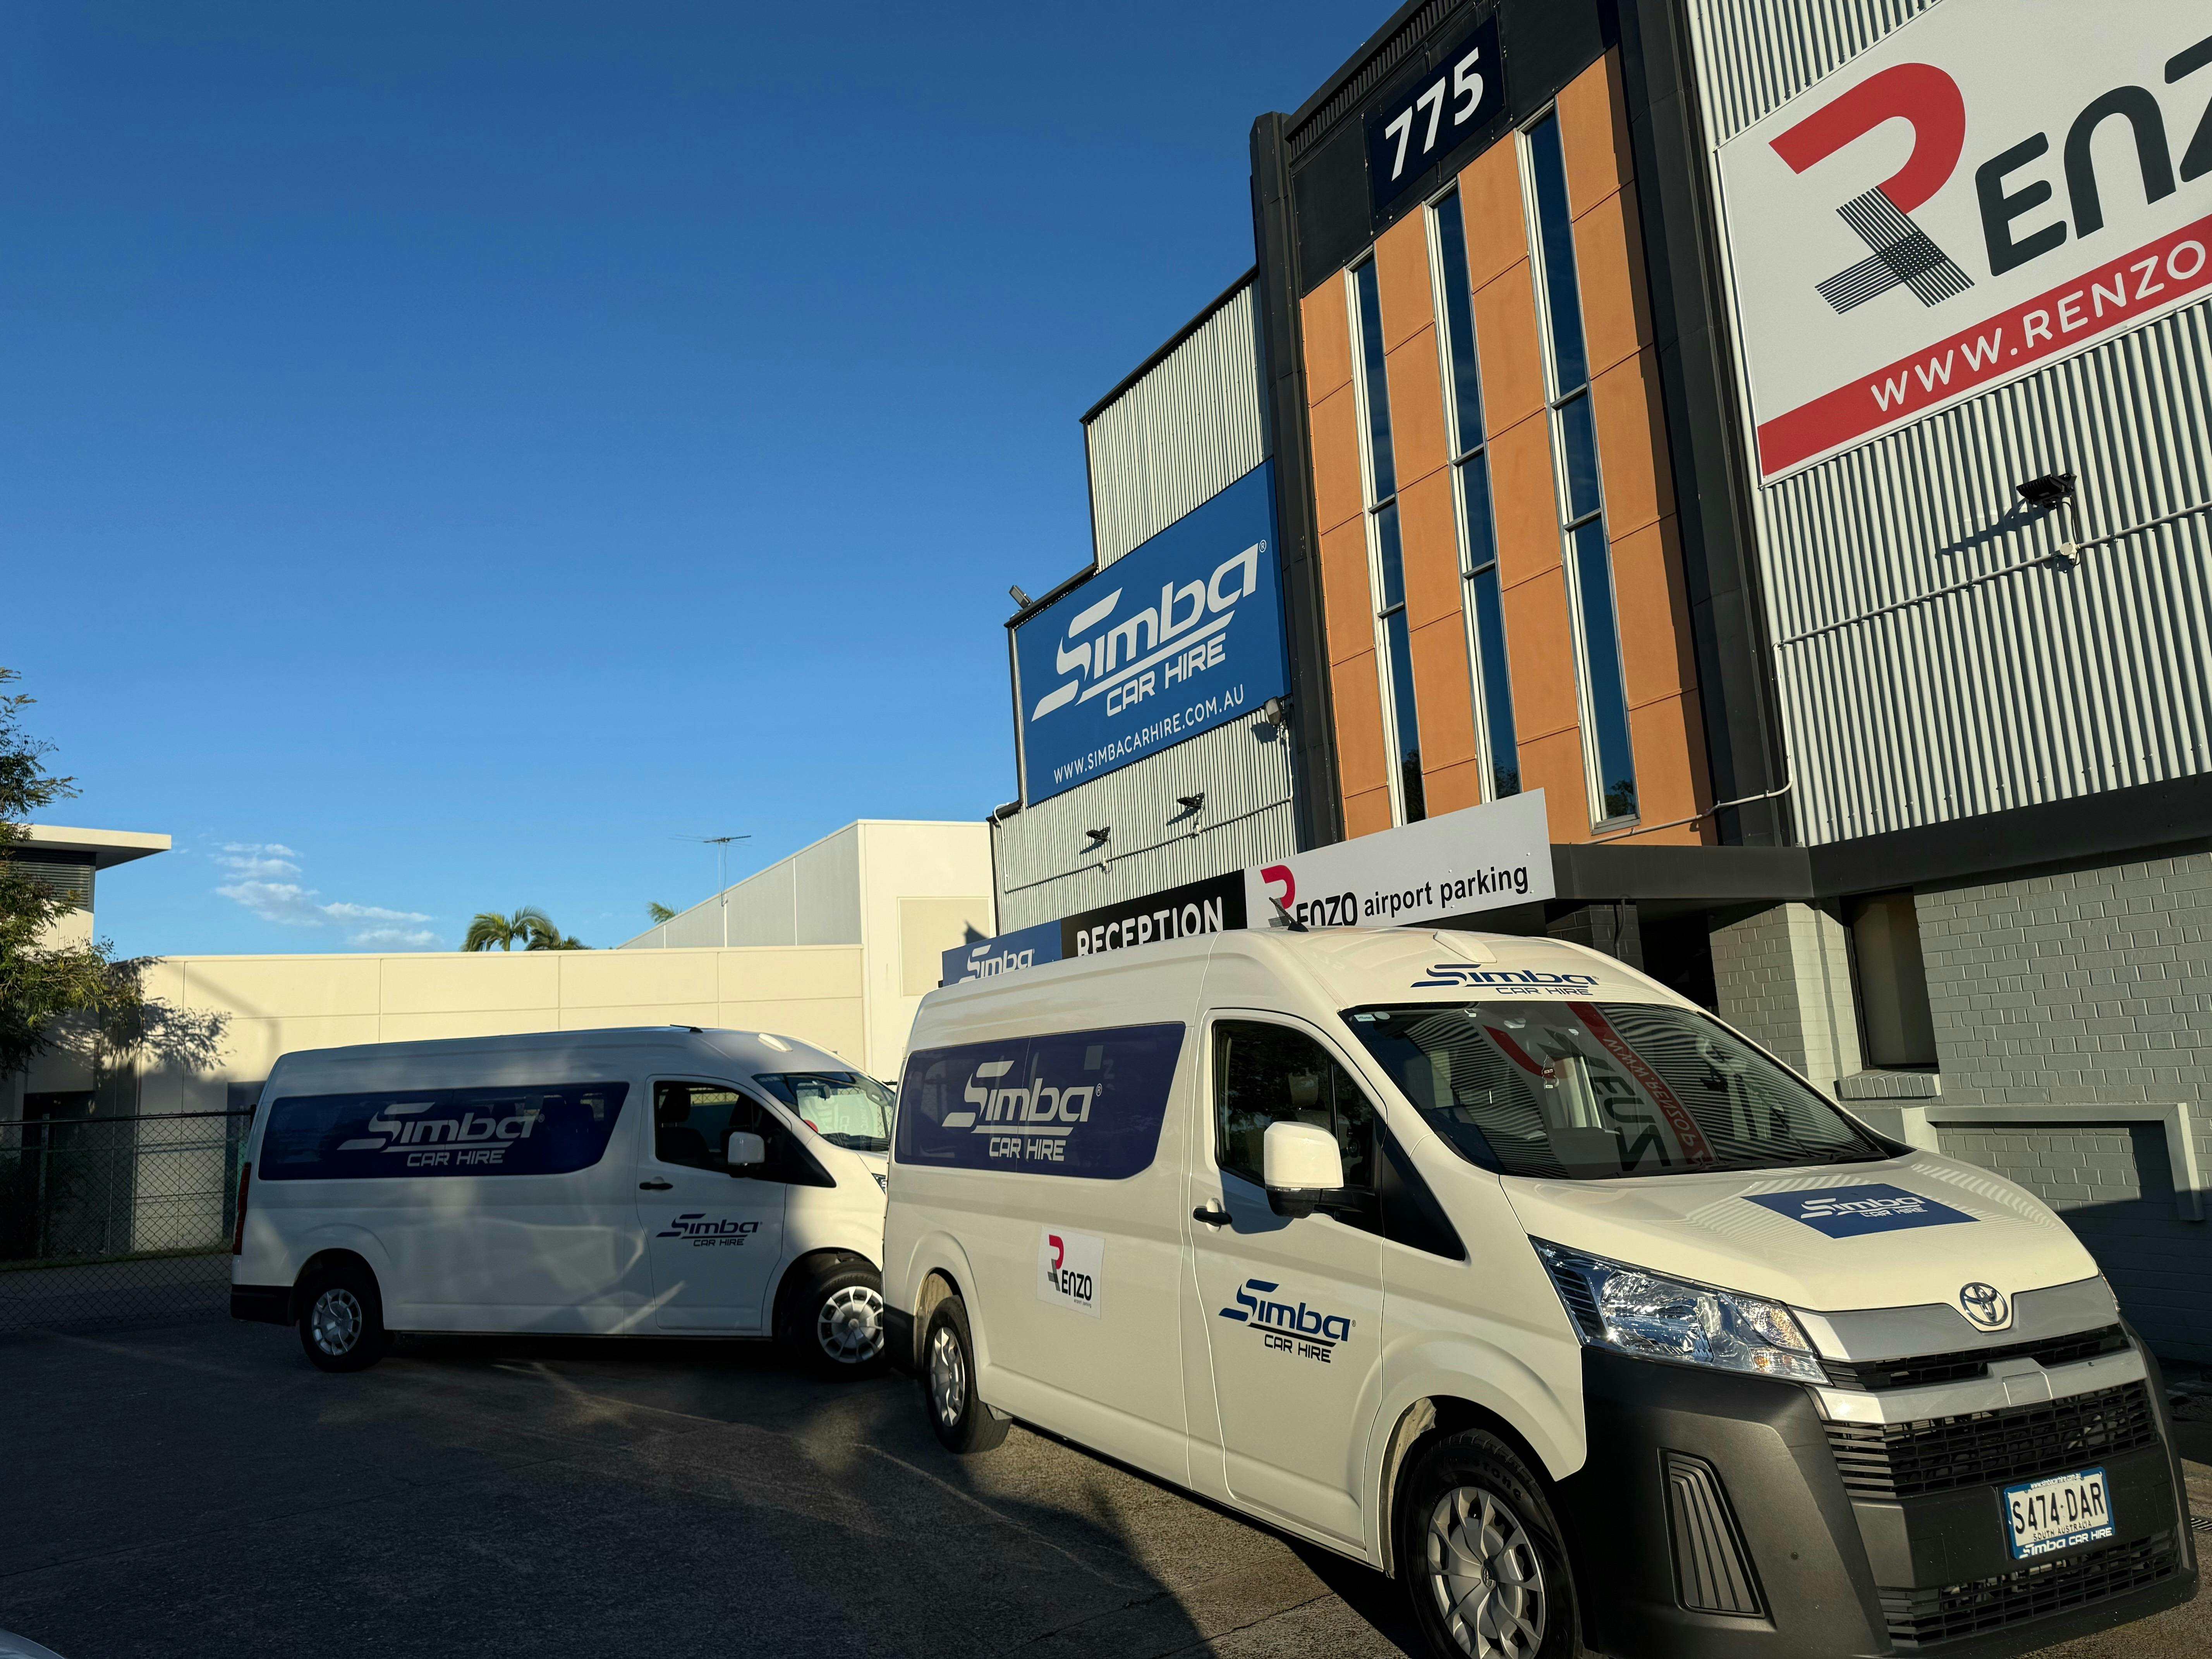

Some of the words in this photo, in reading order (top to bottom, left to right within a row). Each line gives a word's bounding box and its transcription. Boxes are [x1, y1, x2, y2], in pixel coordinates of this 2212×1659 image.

[1385, 46, 1484, 182] 775
[1871, 240, 2206, 411] WWW.RENZO
[1107, 669, 1155, 717] CAR
[1165, 633, 1226, 689] HIRE
[1054, 684, 1244, 784] WWW.SIMBACARHIRE.COM.AU
[1365, 881, 1432, 917] airport
[1441, 866, 1528, 908] parking
[1077, 896, 1223, 956] RECEPTION
[407, 1152, 448, 1166] CAR
[457, 1150, 505, 1165] HIRE
[989, 1137, 1021, 1158] CAR
[1026, 1139, 1066, 1161] HIRE
[1265, 1334, 1292, 1353] CAR
[1298, 1342, 1331, 1363] HIRE
[2019, 1539, 2066, 1559] Simba
[2069, 1533, 2088, 1546] CAR
[2091, 1527, 2112, 1540] HIRE
[2033, 1529, 2055, 1541] SOUTH
[2058, 1520, 2092, 1535] AUSTRALIA
